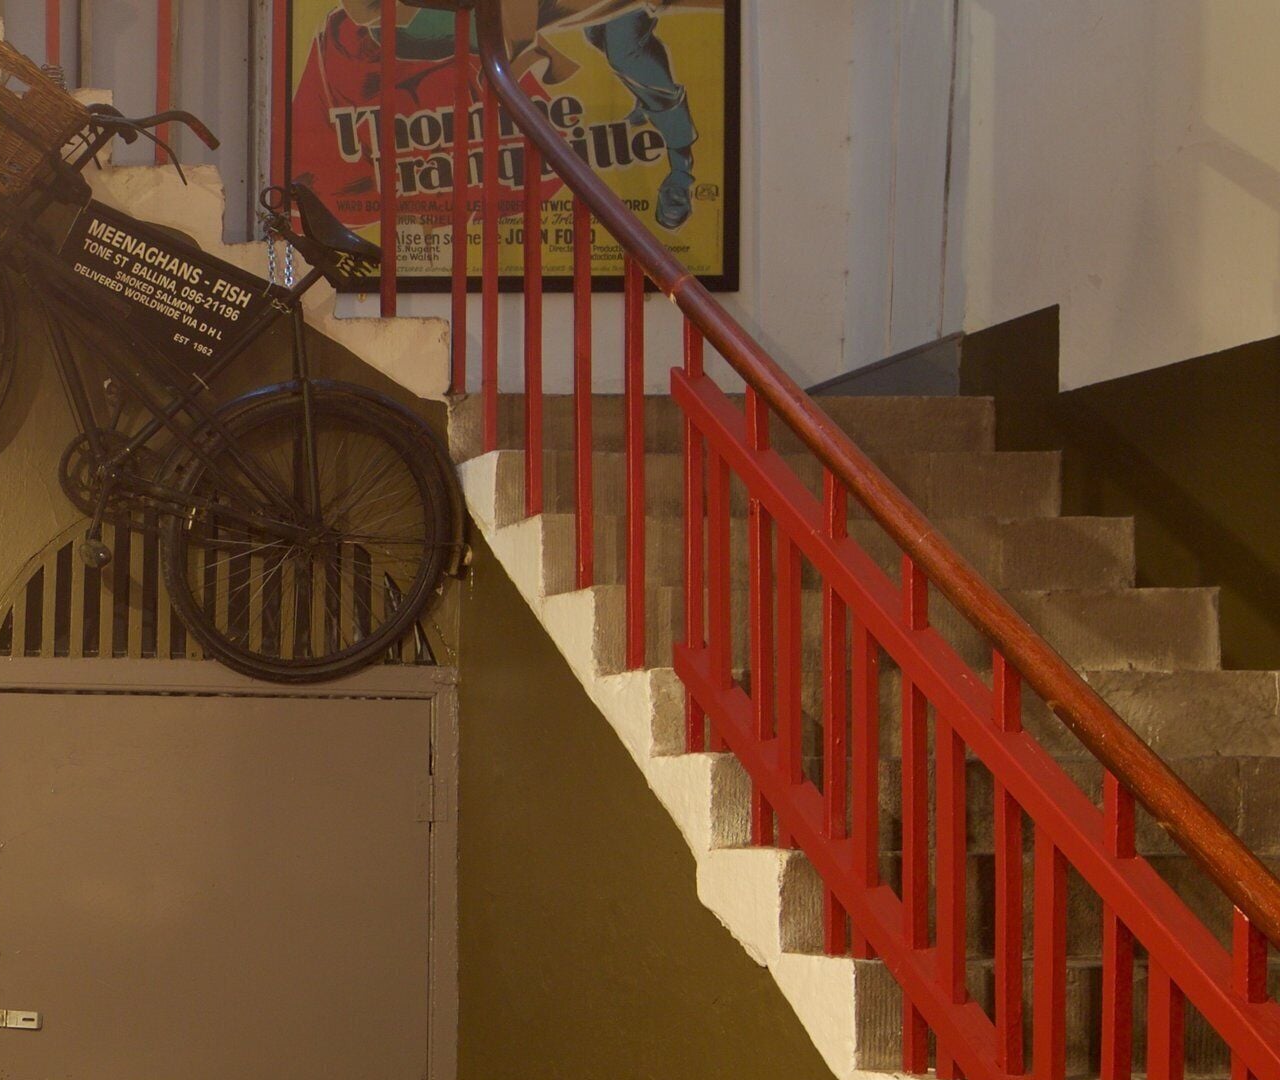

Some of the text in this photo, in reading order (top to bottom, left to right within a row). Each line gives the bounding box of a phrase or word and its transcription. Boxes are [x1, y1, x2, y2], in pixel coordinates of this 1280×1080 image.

[409, 253, 439, 262] Walsh
[424, 233, 440, 245] en
[505, 229, 548, 245] JON
[555, 229, 596, 245] FOD
[83, 238, 240, 321] TONE ST BALLINA, 096-21196
[88, 219, 203, 285] MEENAGHANS
[212, 278, 252, 308] FISH
[74, 262, 123, 292] DELIVERED
[124, 287, 181, 320] WORLDWIDE
[182, 314, 198, 328] VIA
[115, 270, 195, 314] SMOKED SALMON
[173, 332, 213, 357] EST 1962
